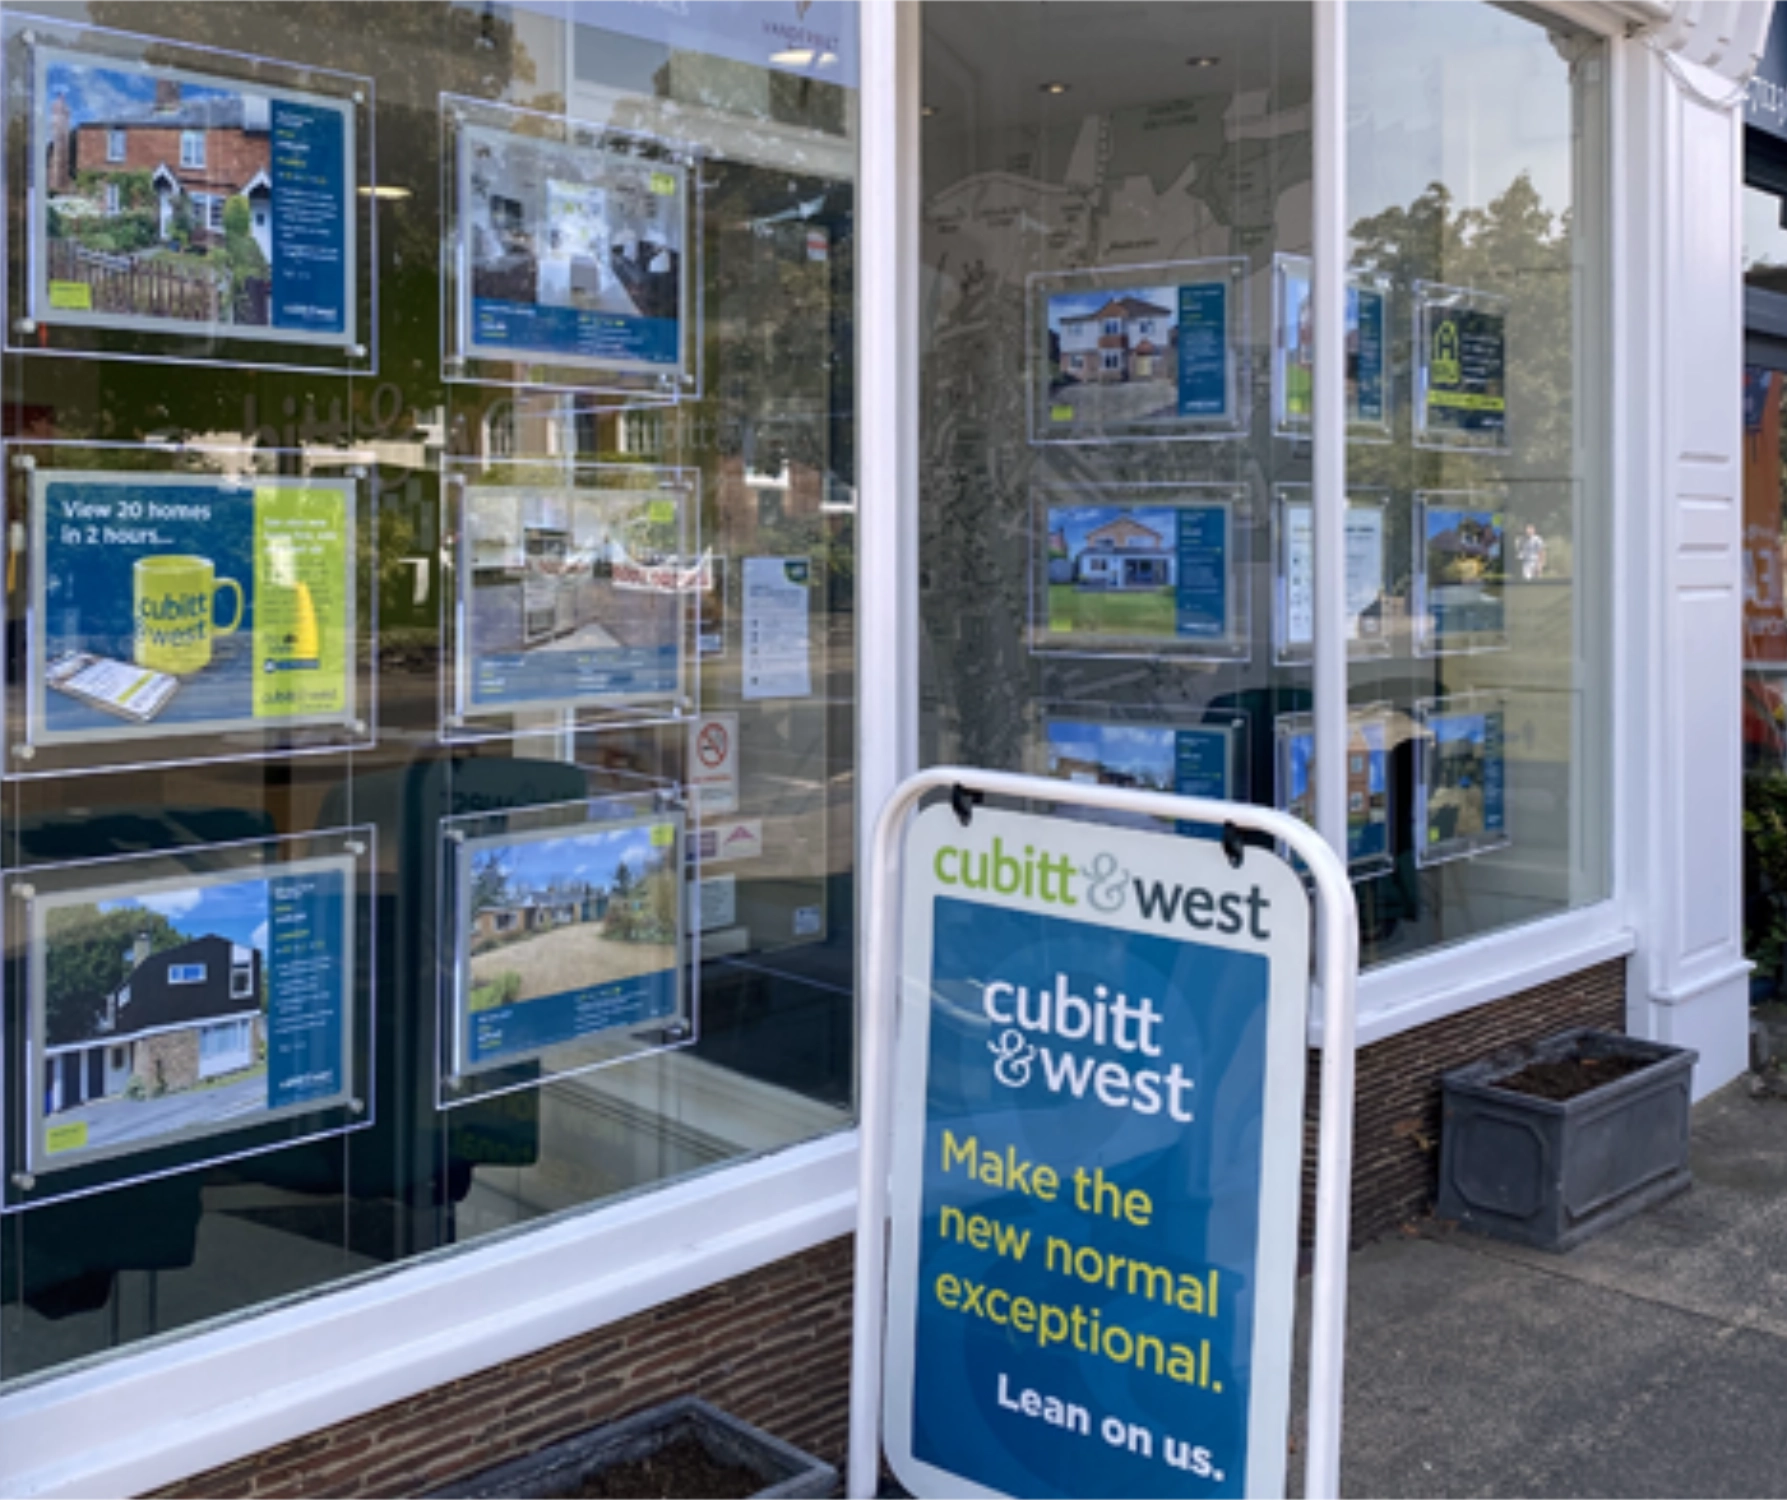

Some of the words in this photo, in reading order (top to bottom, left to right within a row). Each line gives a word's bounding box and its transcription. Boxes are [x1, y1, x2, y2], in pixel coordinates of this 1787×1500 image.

[60, 524, 82, 544] in
[86, 526, 99, 544] 2
[61, 501, 112, 519] View
[117, 501, 143, 520] 20
[148, 502, 212, 521] homes
[142, 592, 207, 621] cubitt
[933, 836, 1078, 907] cubitt
[1133, 876, 1271, 941] west
[983, 971, 1163, 1058] cubitt
[942, 1128, 1059, 1202] Make
[1072, 1166, 1153, 1226] the
[940, 1204, 1031, 1262] new
[1046, 1235, 1219, 1319] normal
[935, 1272, 1224, 1394] exceptional.
[997, 1372, 1092, 1436] Lean
[1100, 1416, 1154, 1458] on
[1162, 1435, 1226, 1482] us.
